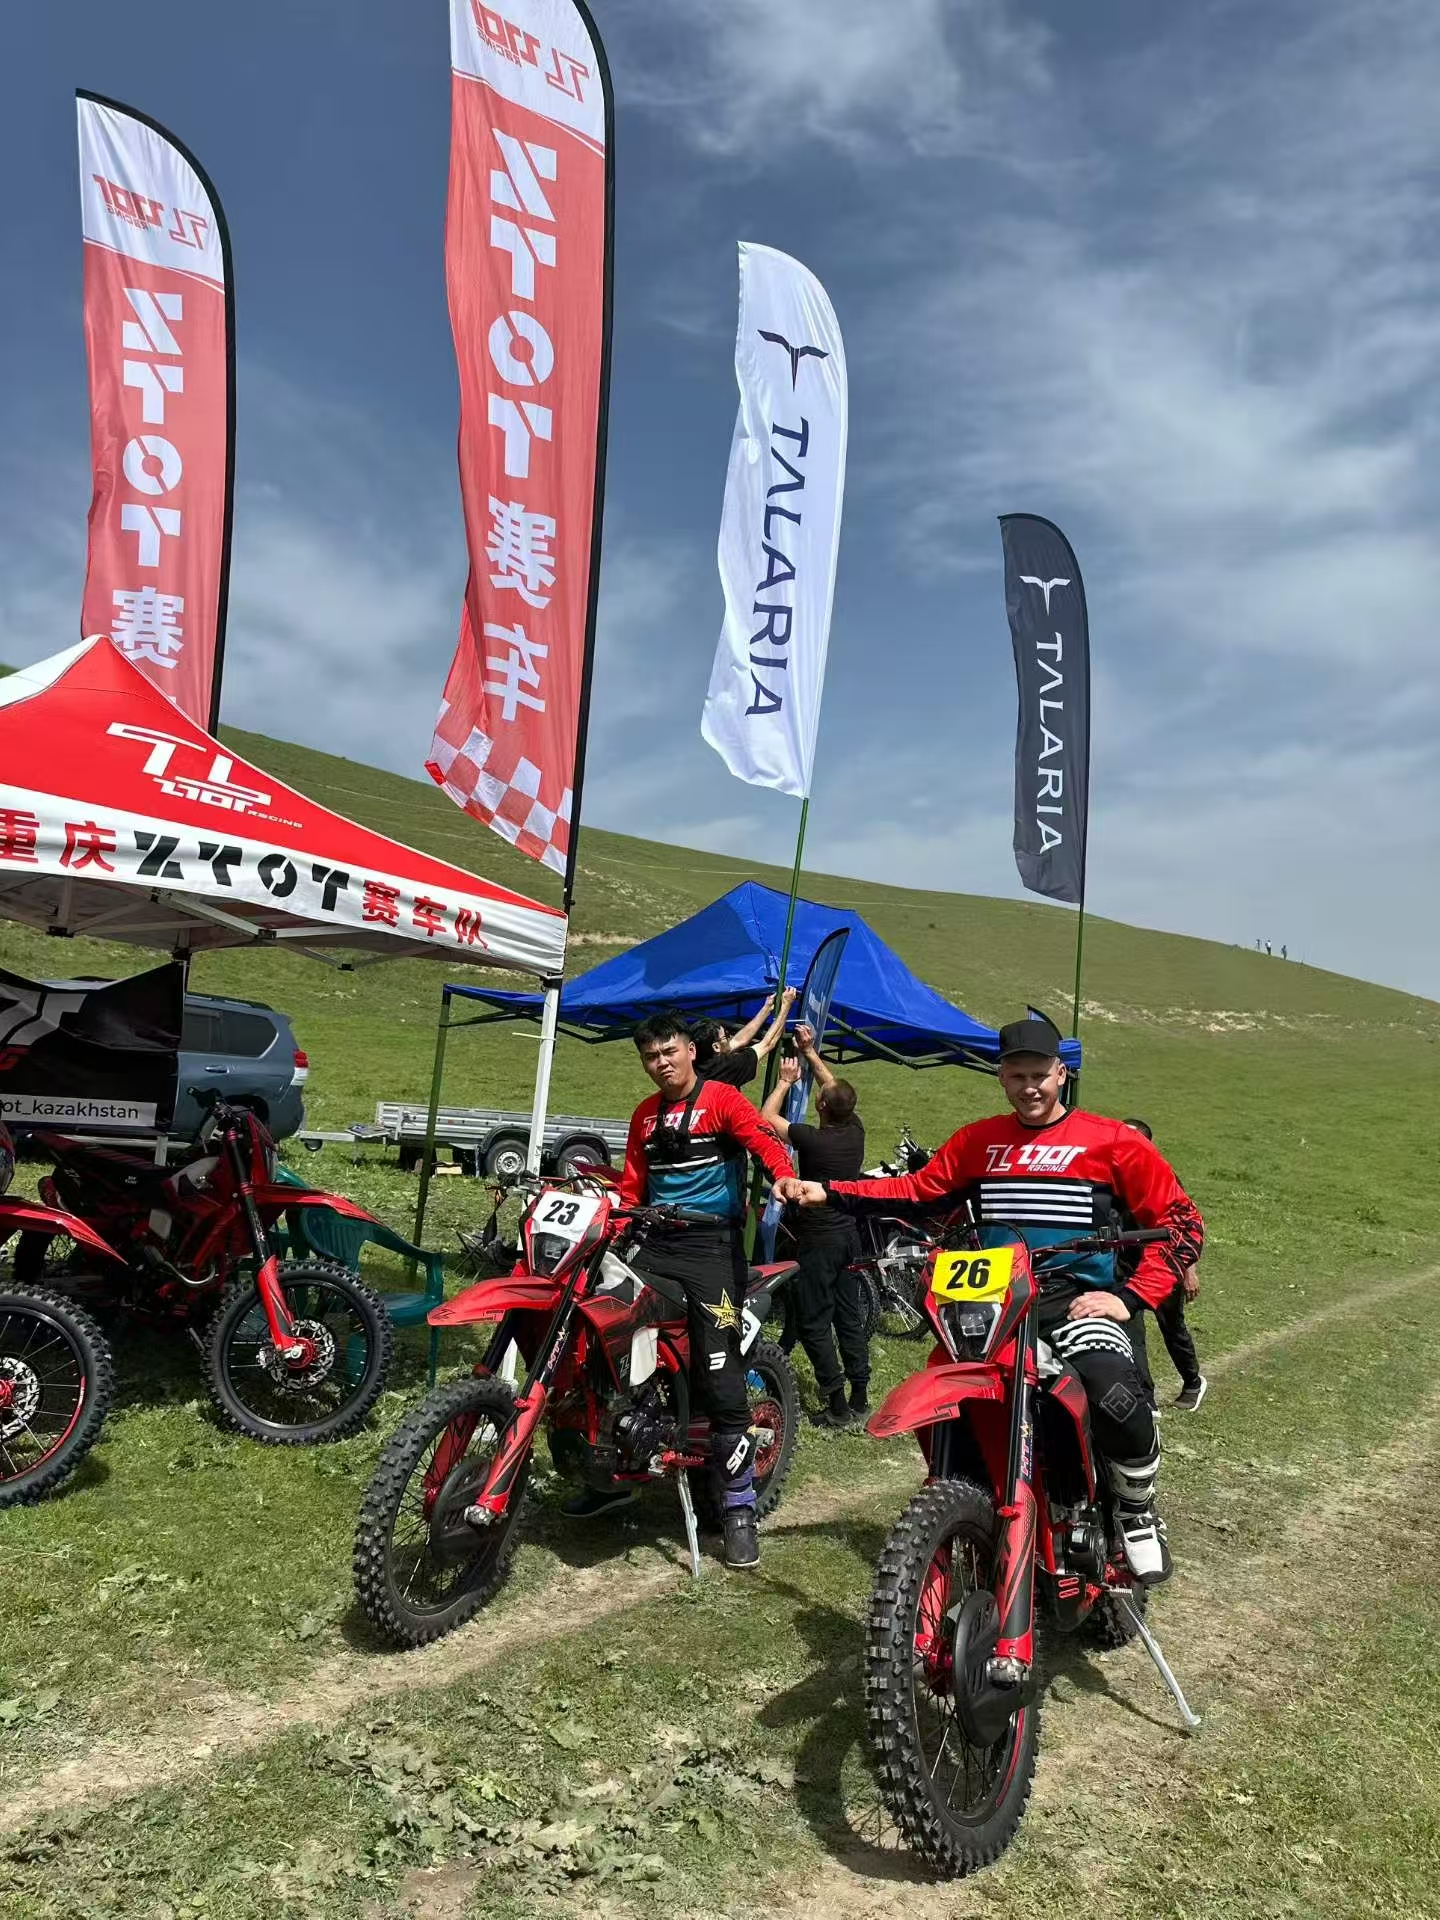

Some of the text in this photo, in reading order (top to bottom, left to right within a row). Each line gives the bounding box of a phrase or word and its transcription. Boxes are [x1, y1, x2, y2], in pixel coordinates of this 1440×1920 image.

[745, 416, 809, 716] TALARIA
[1036, 631, 1063, 854] TALARIA
[247, 810, 303, 829] RACING
[1026, 1164, 1068, 1173] RACING
[542, 1200, 580, 1226] 23
[946, 1258, 991, 1290] 26
